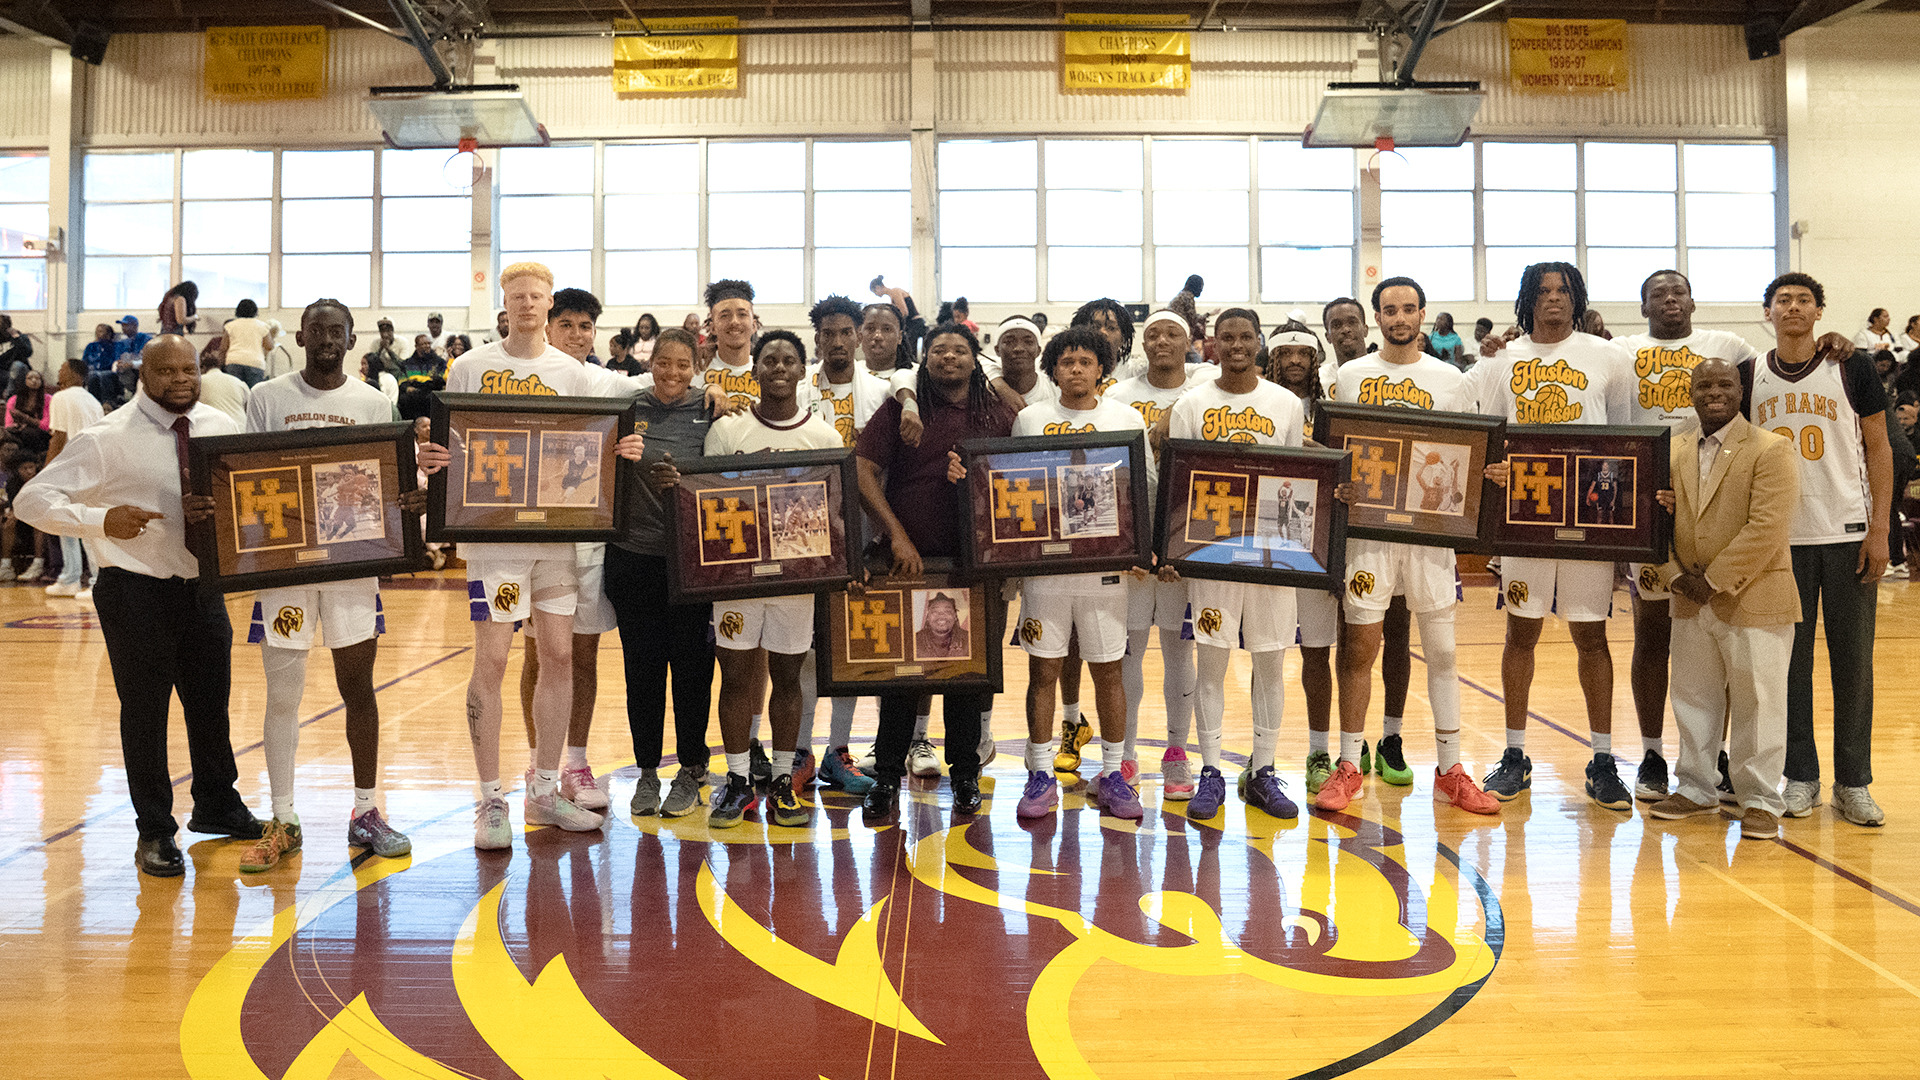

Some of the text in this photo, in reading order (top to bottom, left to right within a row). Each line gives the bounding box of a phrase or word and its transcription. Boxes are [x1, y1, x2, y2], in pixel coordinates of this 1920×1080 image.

[259, 31, 319, 45] CONFERENCE
[1099, 36, 1157, 50] CHAMPIONS
[1511, 39, 1622, 51] CONFERENCE CO-CHAMPIONS
[1546, 24, 1589, 36] BIG STATE
[1117, 71, 1146, 83] TRACK
[1149, 71, 1156, 83] &
[1549, 56, 1586, 68] 1996-97
[1563, 74, 1616, 87] VOLLEYBALL
[1358, 375, 1434, 410] Huston
[1510, 358, 1588, 395] Huston
[284, 413, 356, 426] BRAELON SEALS
[1202, 405, 1275, 441] Huston
[1757, 392, 1838, 425] HT RAMS
[470, 440, 524, 496] HT
[994, 478, 1045, 531] HT
[1511, 462, 1562, 515] HT
[236, 478, 298, 538] HT
[702, 497, 755, 554] HT
[1192, 480, 1244, 536] HT
[850, 600, 900, 653] HT
